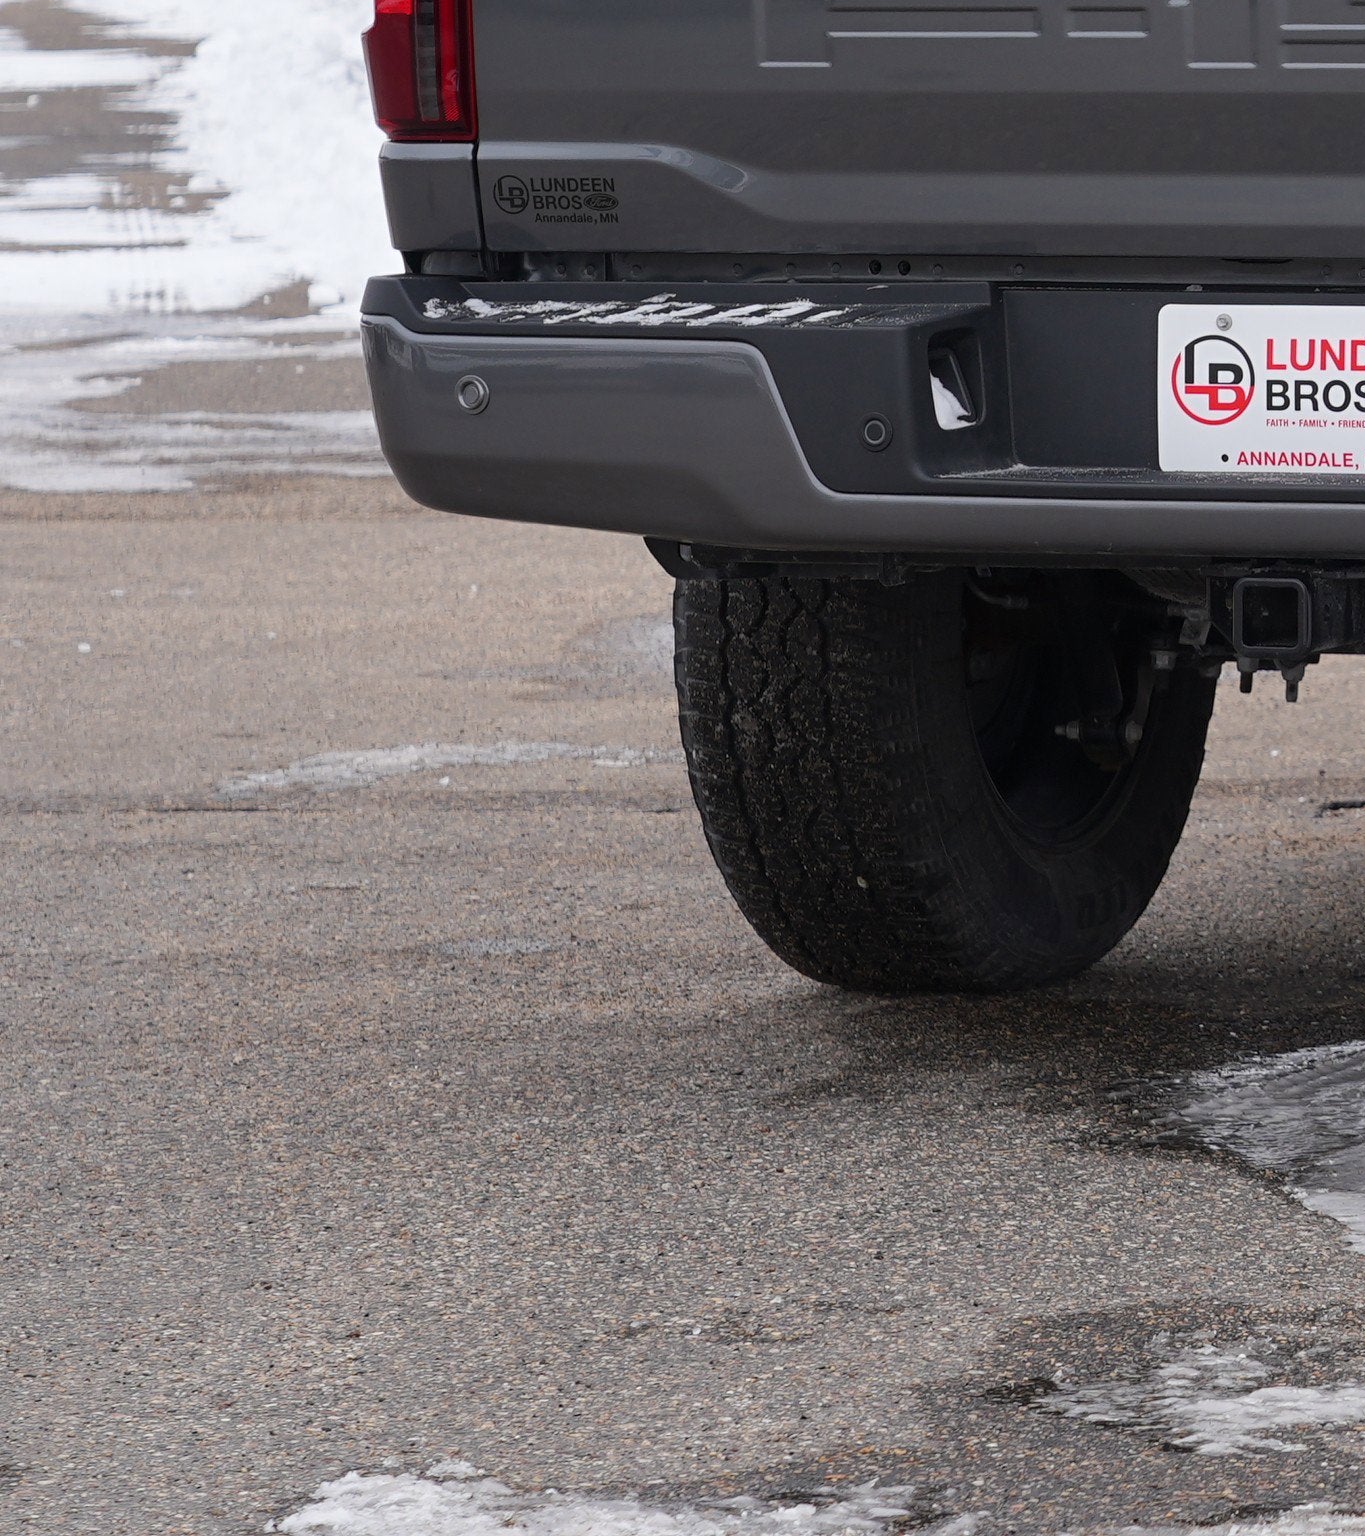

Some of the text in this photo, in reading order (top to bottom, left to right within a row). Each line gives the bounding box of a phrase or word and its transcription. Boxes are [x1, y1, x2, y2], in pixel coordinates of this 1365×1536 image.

[529, 177, 616, 193] LUNDEEN
[532, 195, 583, 210] BROS
[600, 214, 619, 224] MN
[1266, 418, 1290, 428] FAITH
[1299, 419, 1329, 428] FAMILY
[1236, 450, 1361, 470] ANNANDALE,
